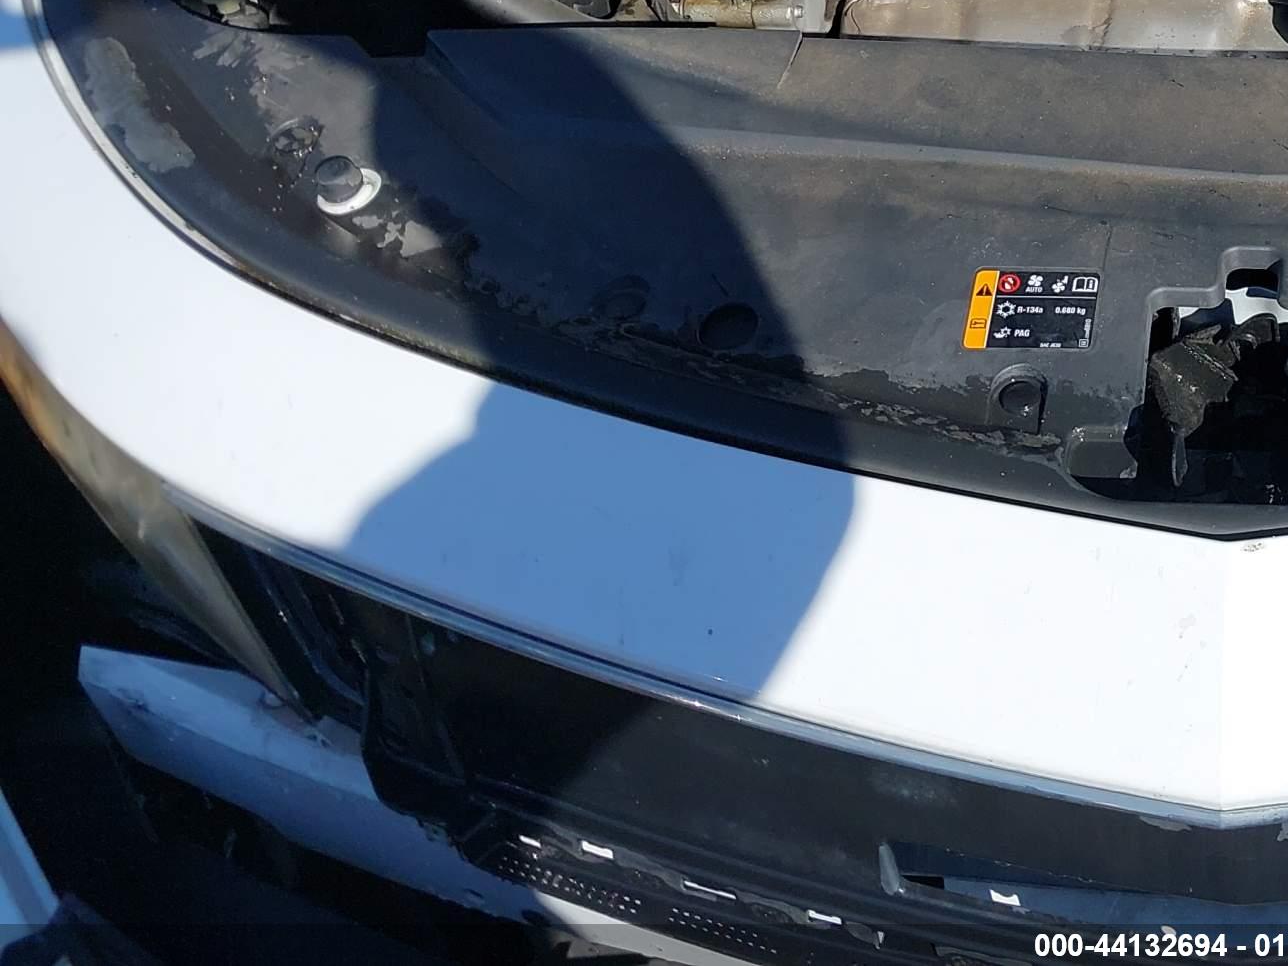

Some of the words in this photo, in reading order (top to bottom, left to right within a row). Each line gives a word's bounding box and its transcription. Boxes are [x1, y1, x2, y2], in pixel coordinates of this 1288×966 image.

[1017, 306, 1044, 314] R-134a
[1076, 306, 1087, 316] kg
[1014, 329, 1030, 337] PAG
